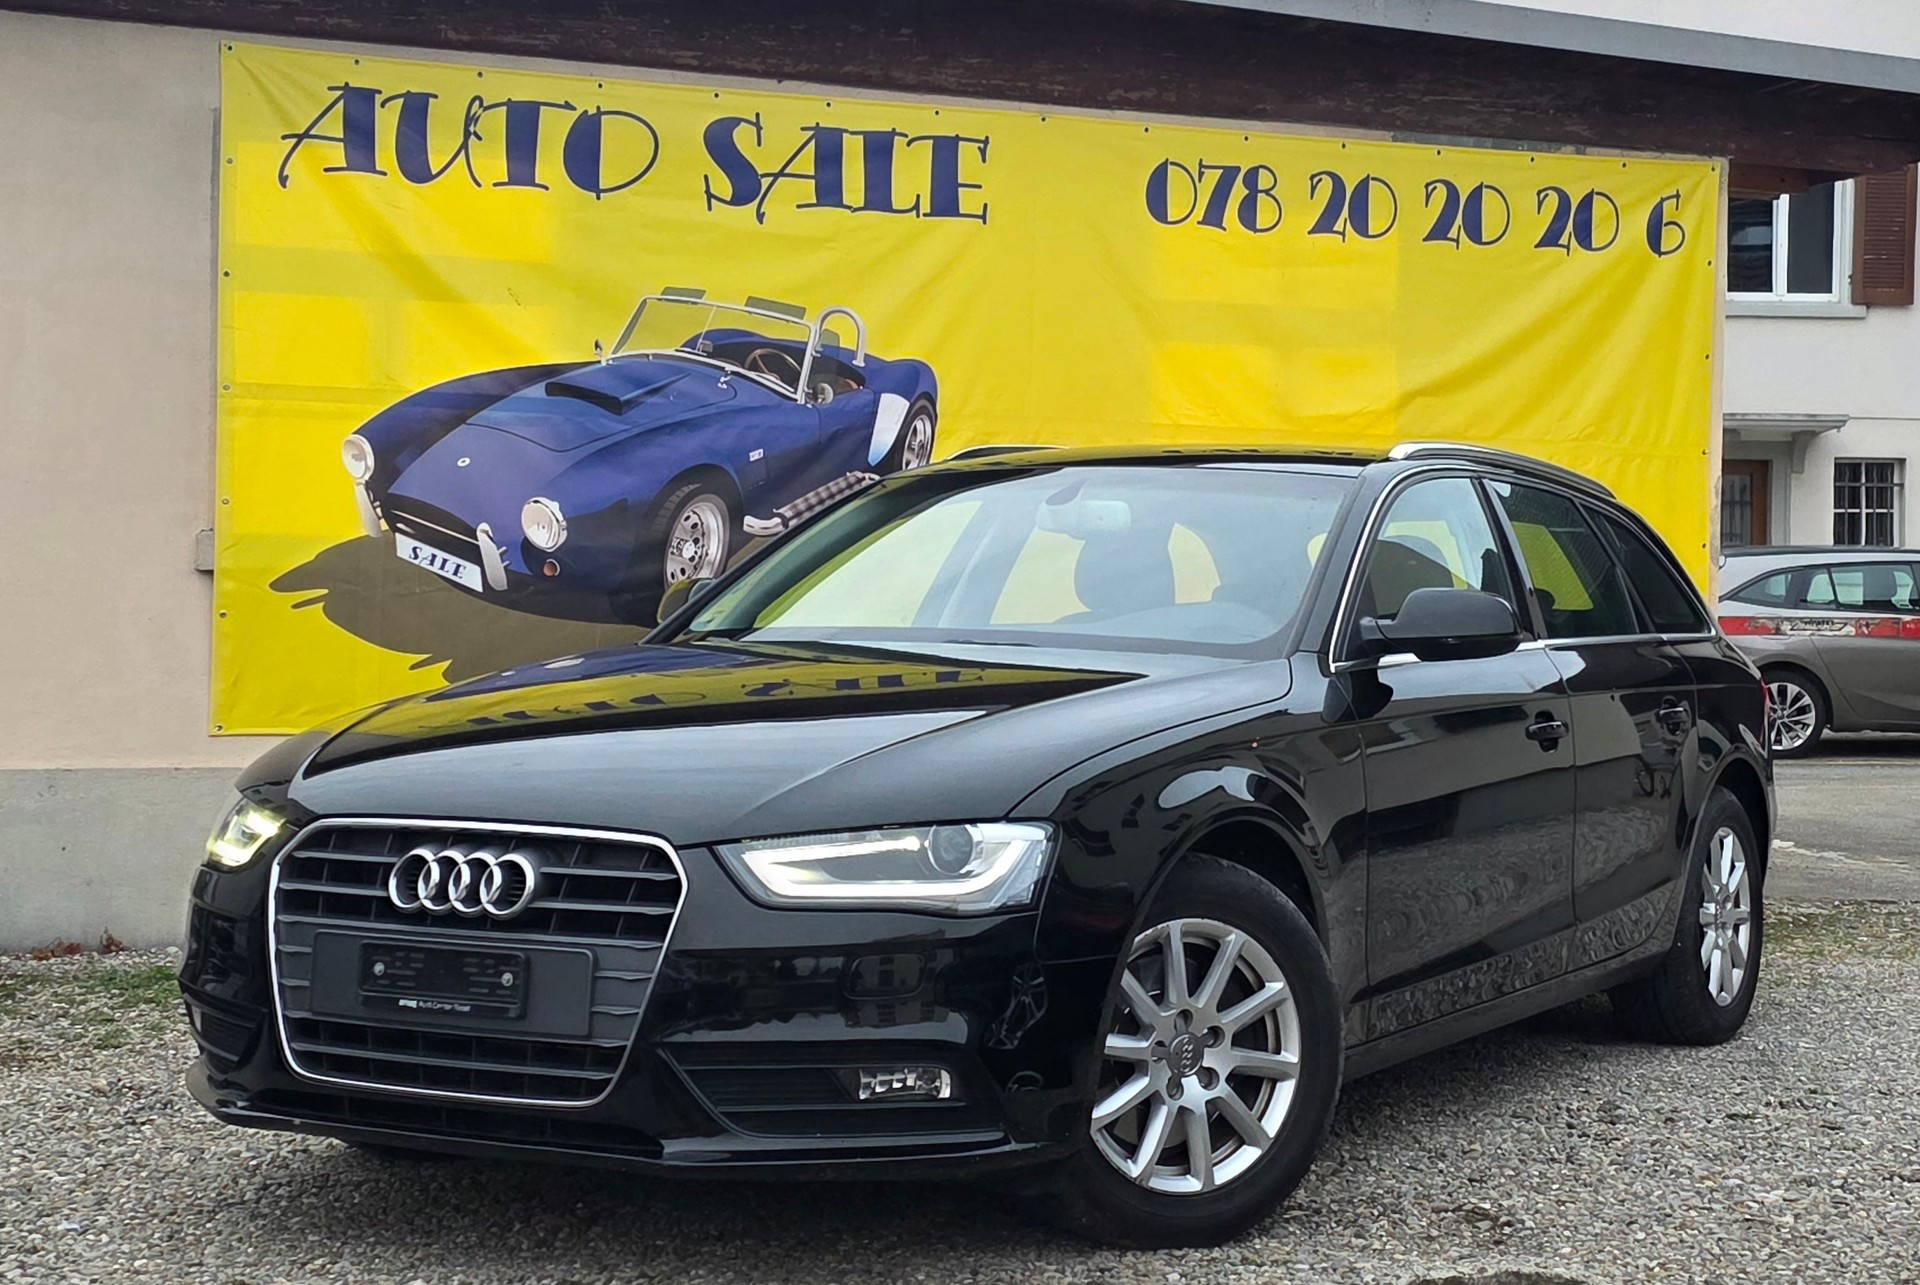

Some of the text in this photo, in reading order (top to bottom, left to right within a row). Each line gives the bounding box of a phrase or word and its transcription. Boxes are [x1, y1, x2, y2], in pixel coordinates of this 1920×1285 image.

[280, 82, 990, 225] AUTO SALE
[1146, 159, 1686, 257] 078 20 20 20 6
[409, 545, 467, 579] SALE
